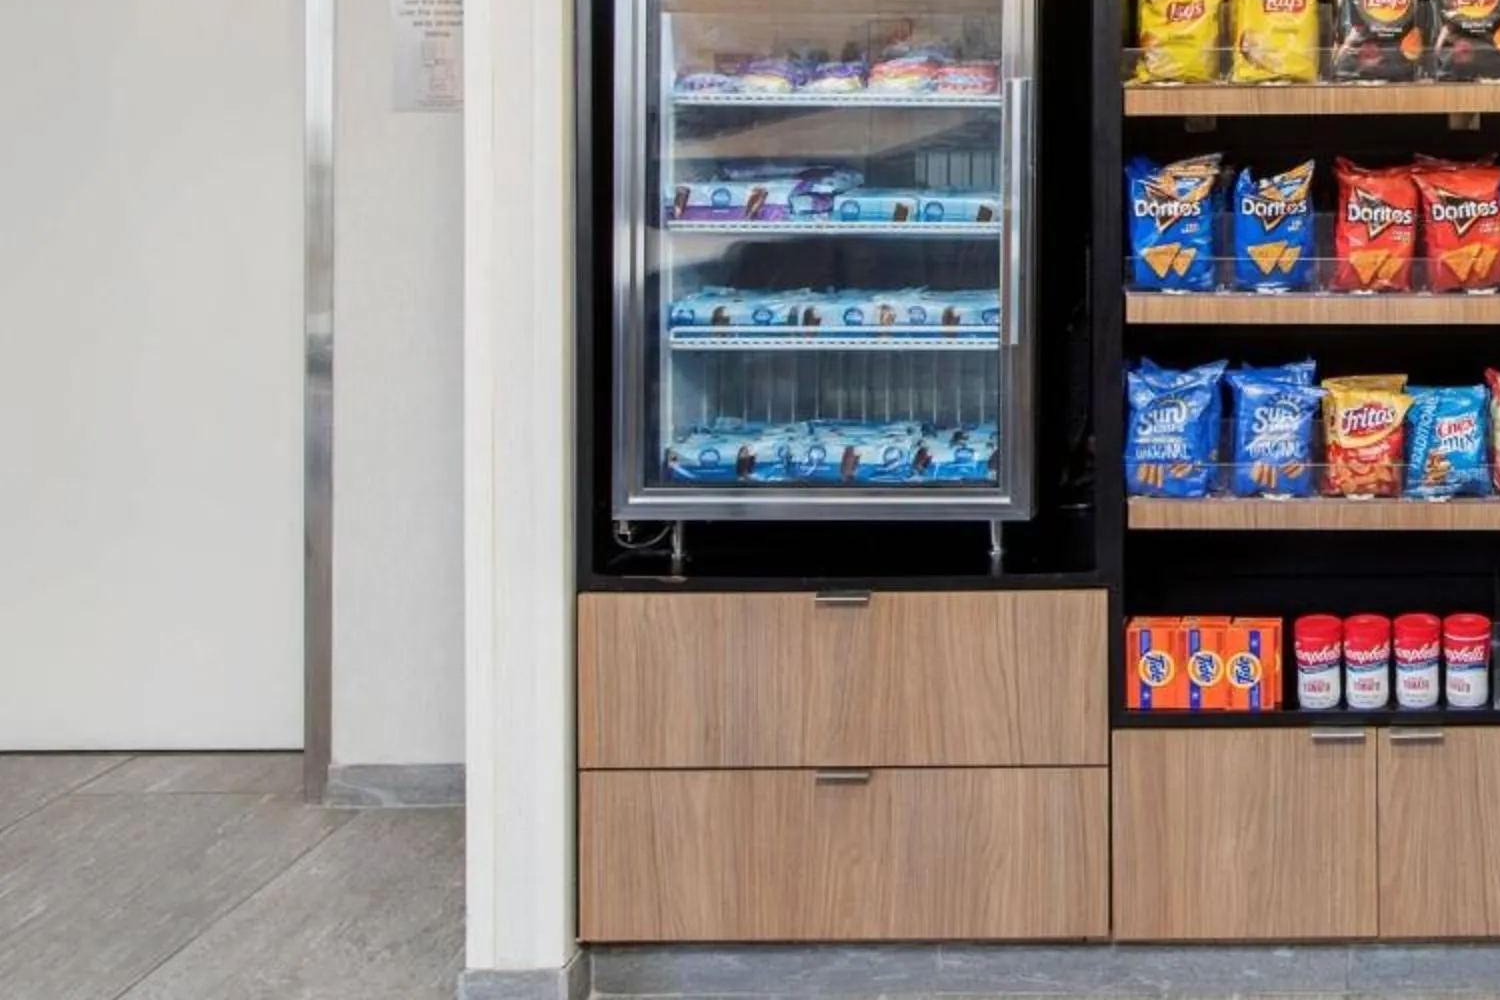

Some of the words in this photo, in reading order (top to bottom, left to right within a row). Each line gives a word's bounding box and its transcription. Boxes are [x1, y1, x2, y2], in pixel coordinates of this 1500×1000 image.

[1134, 199, 1201, 217] Doritos
[1241, 198, 1307, 216] Doritos
[1348, 203, 1413, 224] Doritos
[1432, 200, 1498, 221] Doritos
